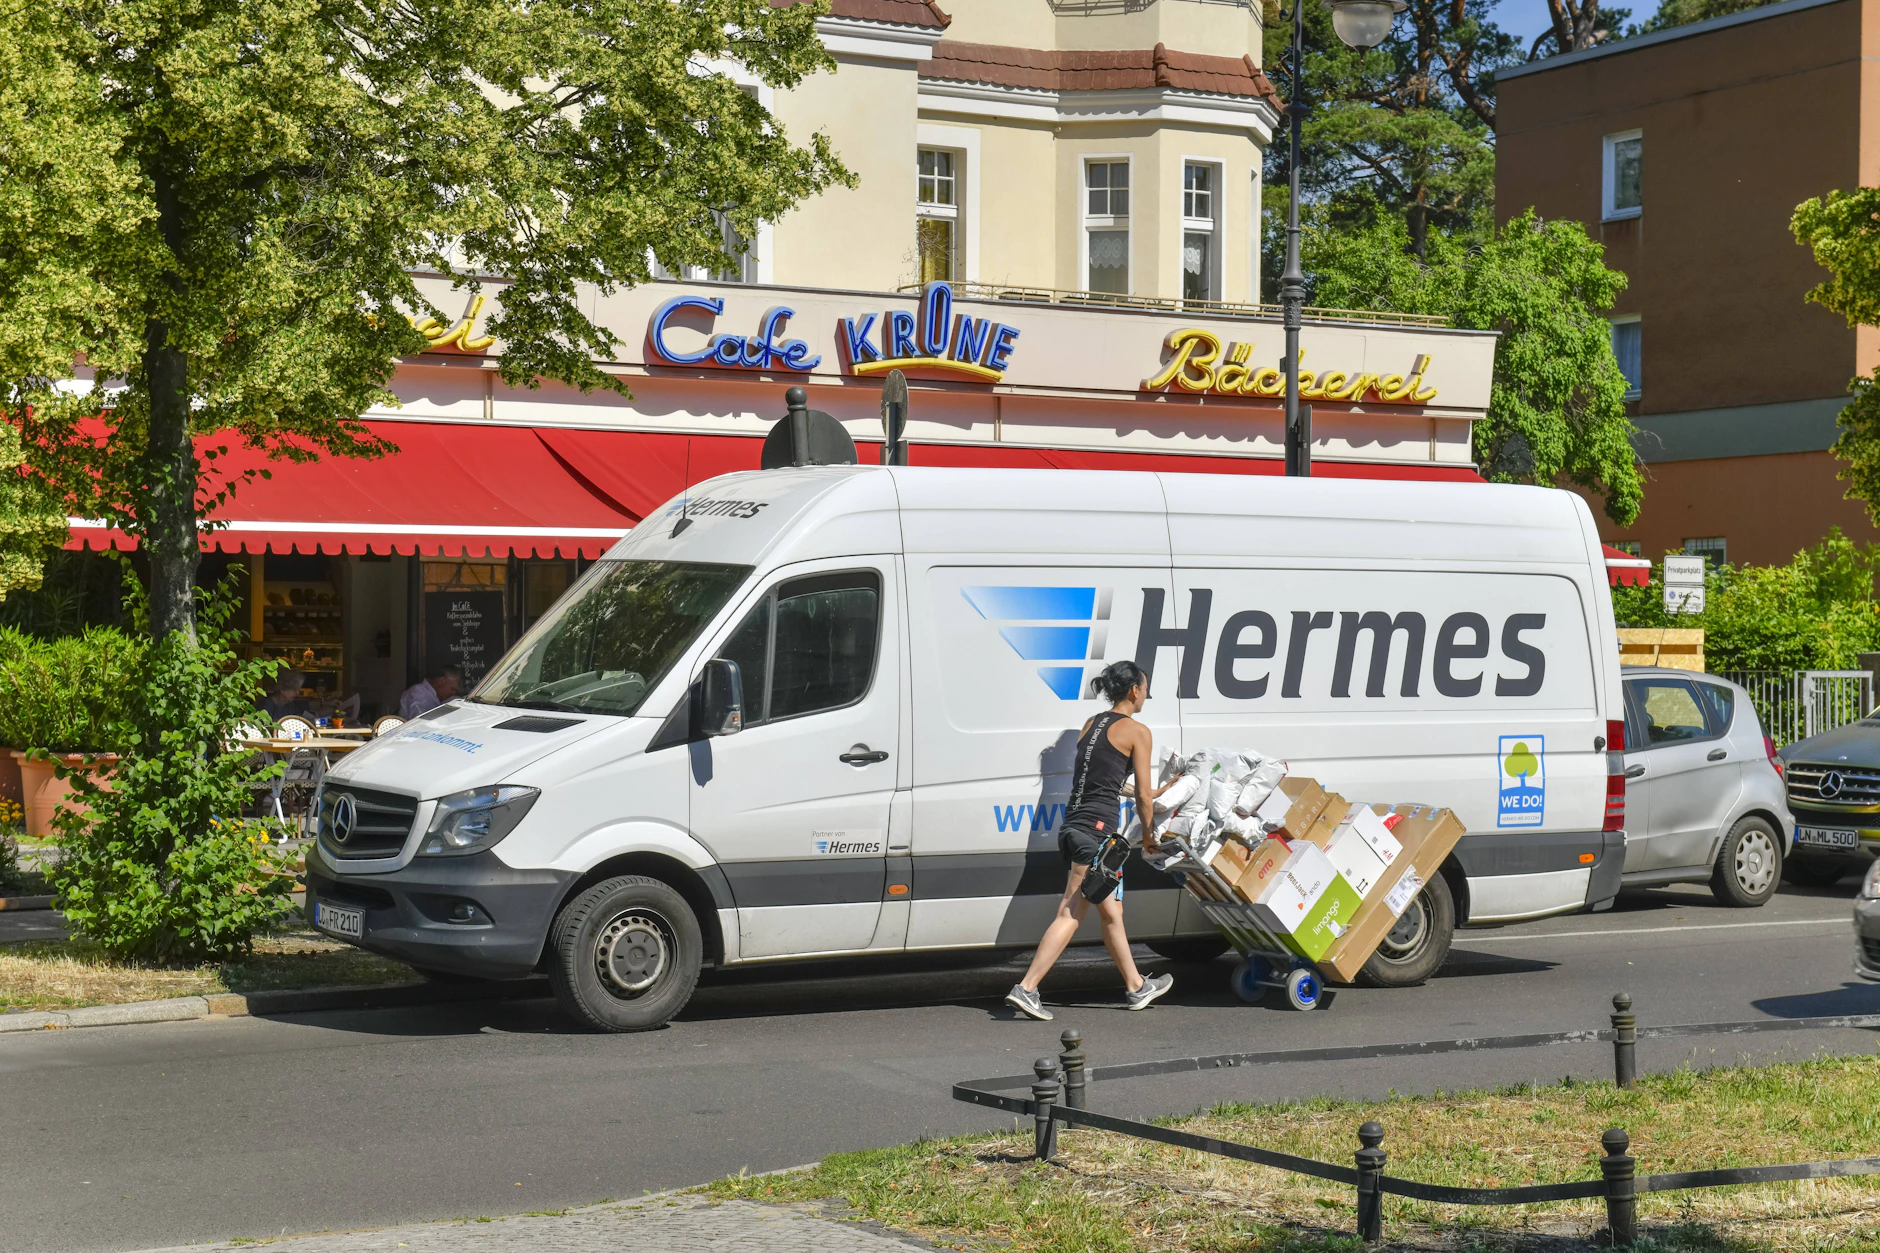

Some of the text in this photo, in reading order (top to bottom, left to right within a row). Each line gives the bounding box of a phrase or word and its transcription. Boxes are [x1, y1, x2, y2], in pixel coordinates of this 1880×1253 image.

[648, 281, 1022, 371] Cafe KRONE
[674, 497, 769, 519] Hermes
[1667, 566, 1701, 575] Privatparkplatz
[1134, 587, 1547, 700] Hermes
[1501, 795, 1543, 808] WE DO!
[1295, 793, 1326, 837] ESPRIT
[828, 841, 880, 854] Hermes
[1799, 829, 1853, 845] LN ML 500
[1258, 858, 1274, 880] OTTO
[329, 910, 340, 930] FR
[340, 913, 359, 934] 210
[1312, 899, 1340, 936] limango
